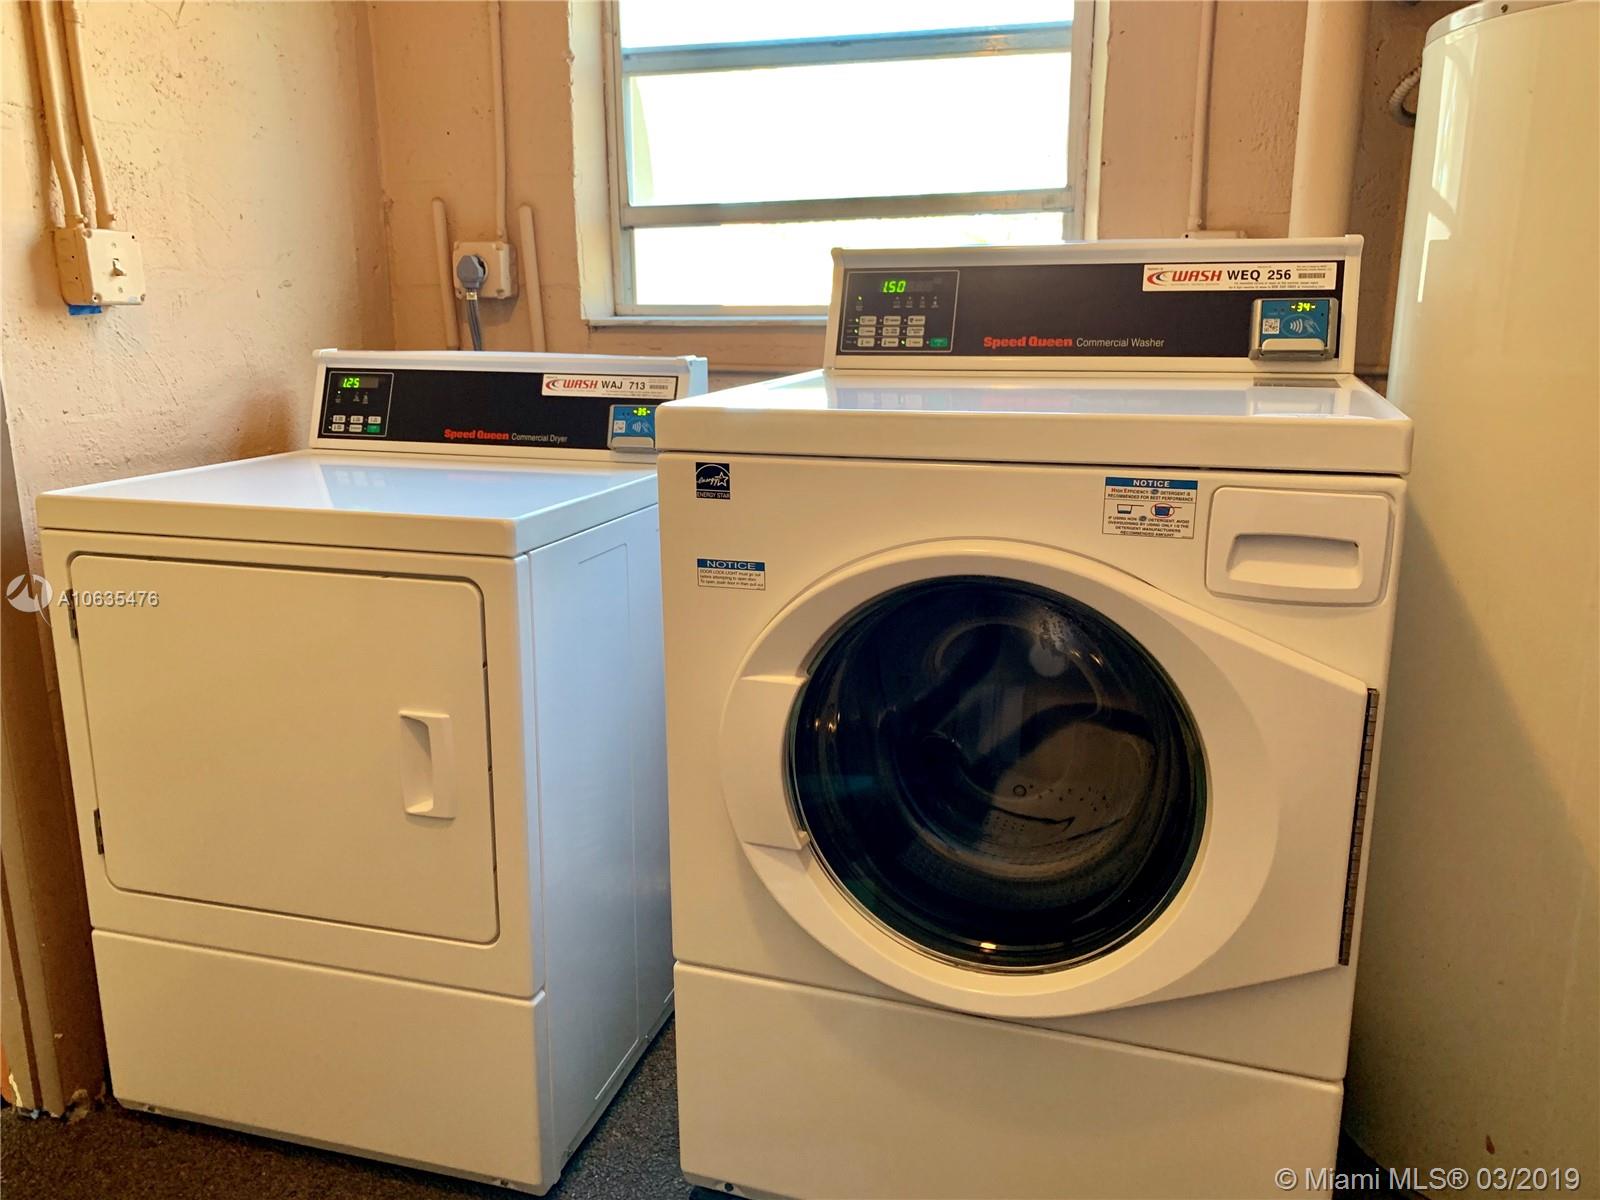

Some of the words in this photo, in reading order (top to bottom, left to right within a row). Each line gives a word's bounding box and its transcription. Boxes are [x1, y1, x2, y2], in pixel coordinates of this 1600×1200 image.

[1171, 270, 1222, 282] WASH
[1227, 269, 1261, 281] WEQ
[1268, 269, 1292, 280] 256
[984, 336, 1026, 349] Speed
[1028, 336, 1072, 347] Queen
[1076, 337, 1128, 347] Commercial
[1132, 338, 1165, 347] Washer
[562, 380, 598, 389] WASH
[601, 380, 622, 390] WAJ
[629, 382, 646, 390] 713
[444, 429, 476, 439] Speed
[477, 430, 509, 440] Queen
[512, 433, 548, 441] Commercial
[550, 434, 568, 444] Dryer
[707, 560, 756, 570] NOTICE
